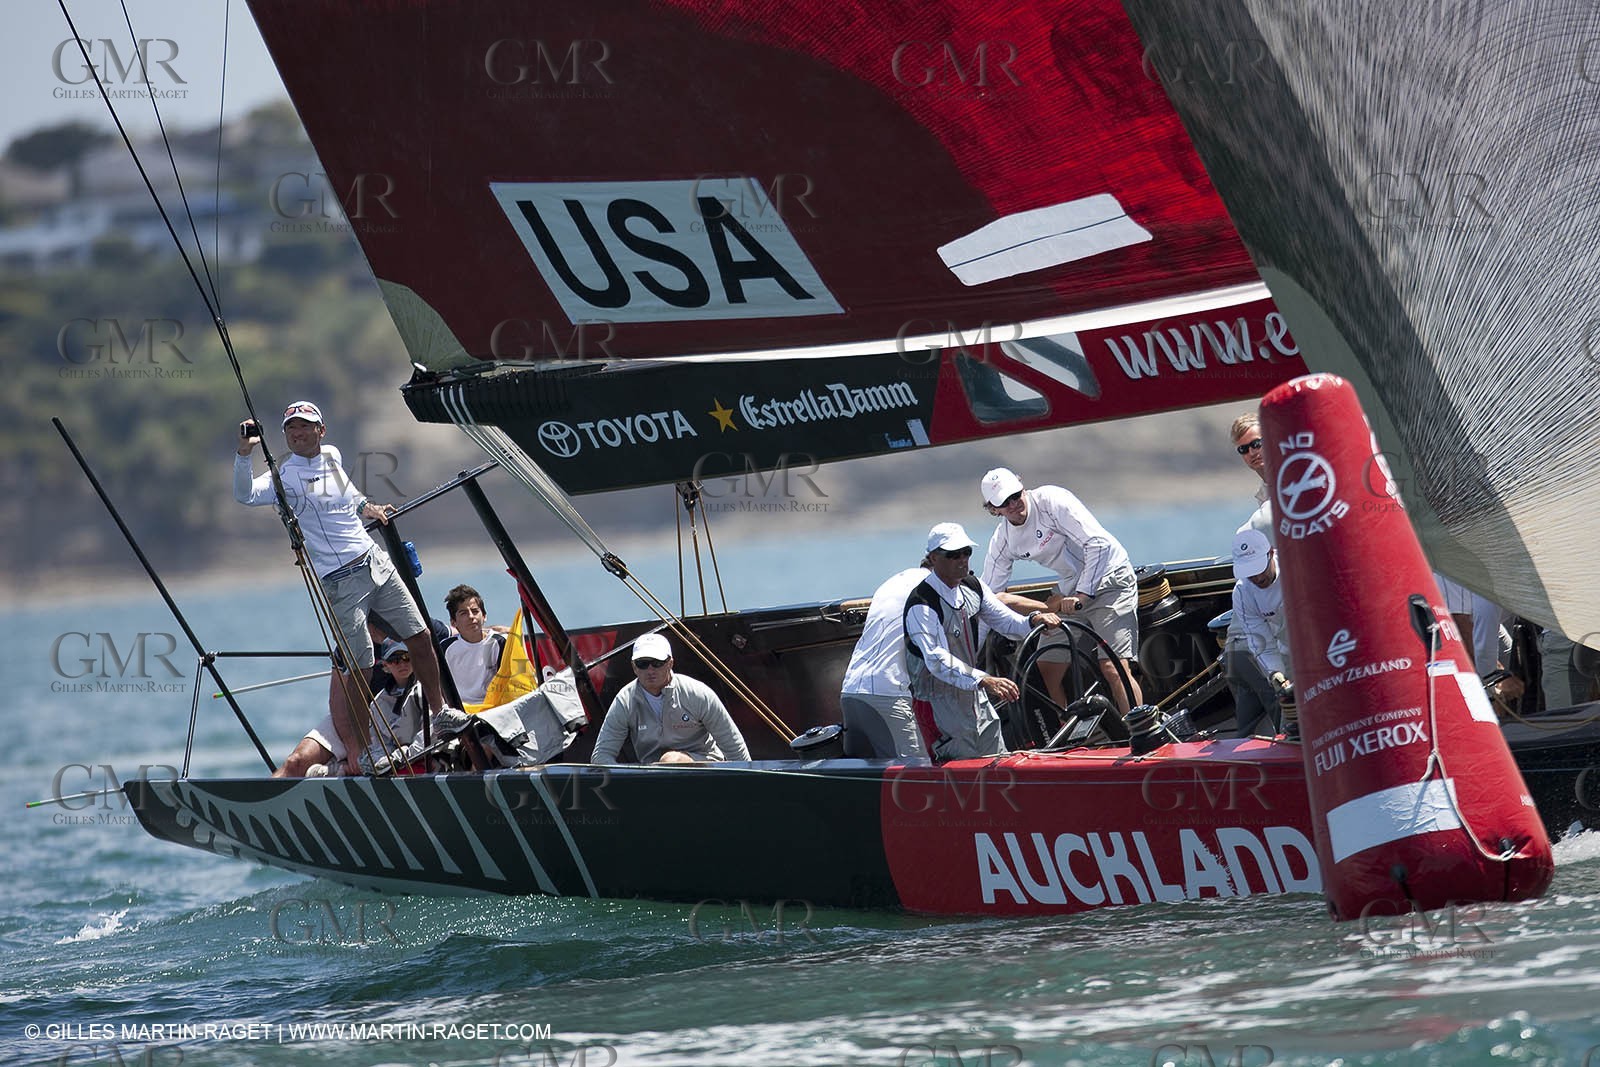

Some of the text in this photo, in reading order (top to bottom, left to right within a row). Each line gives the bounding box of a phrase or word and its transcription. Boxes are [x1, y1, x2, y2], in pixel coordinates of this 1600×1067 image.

[516, 198, 817, 309] USA
[577, 409, 698, 449] TOYOTA
[1278, 431, 1315, 456] NO
[1279, 499, 1350, 540] BOATS
[1317, 672, 1345, 694] NEW
[1346, 657, 1412, 682] ZEALAND
[1323, 715, 1373, 742] DOCUMENT
[1374, 707, 1423, 723] COMPANY
[1314, 720, 1429, 776] FUJI XEROX
[974, 826, 1324, 905] AUCKLAND
